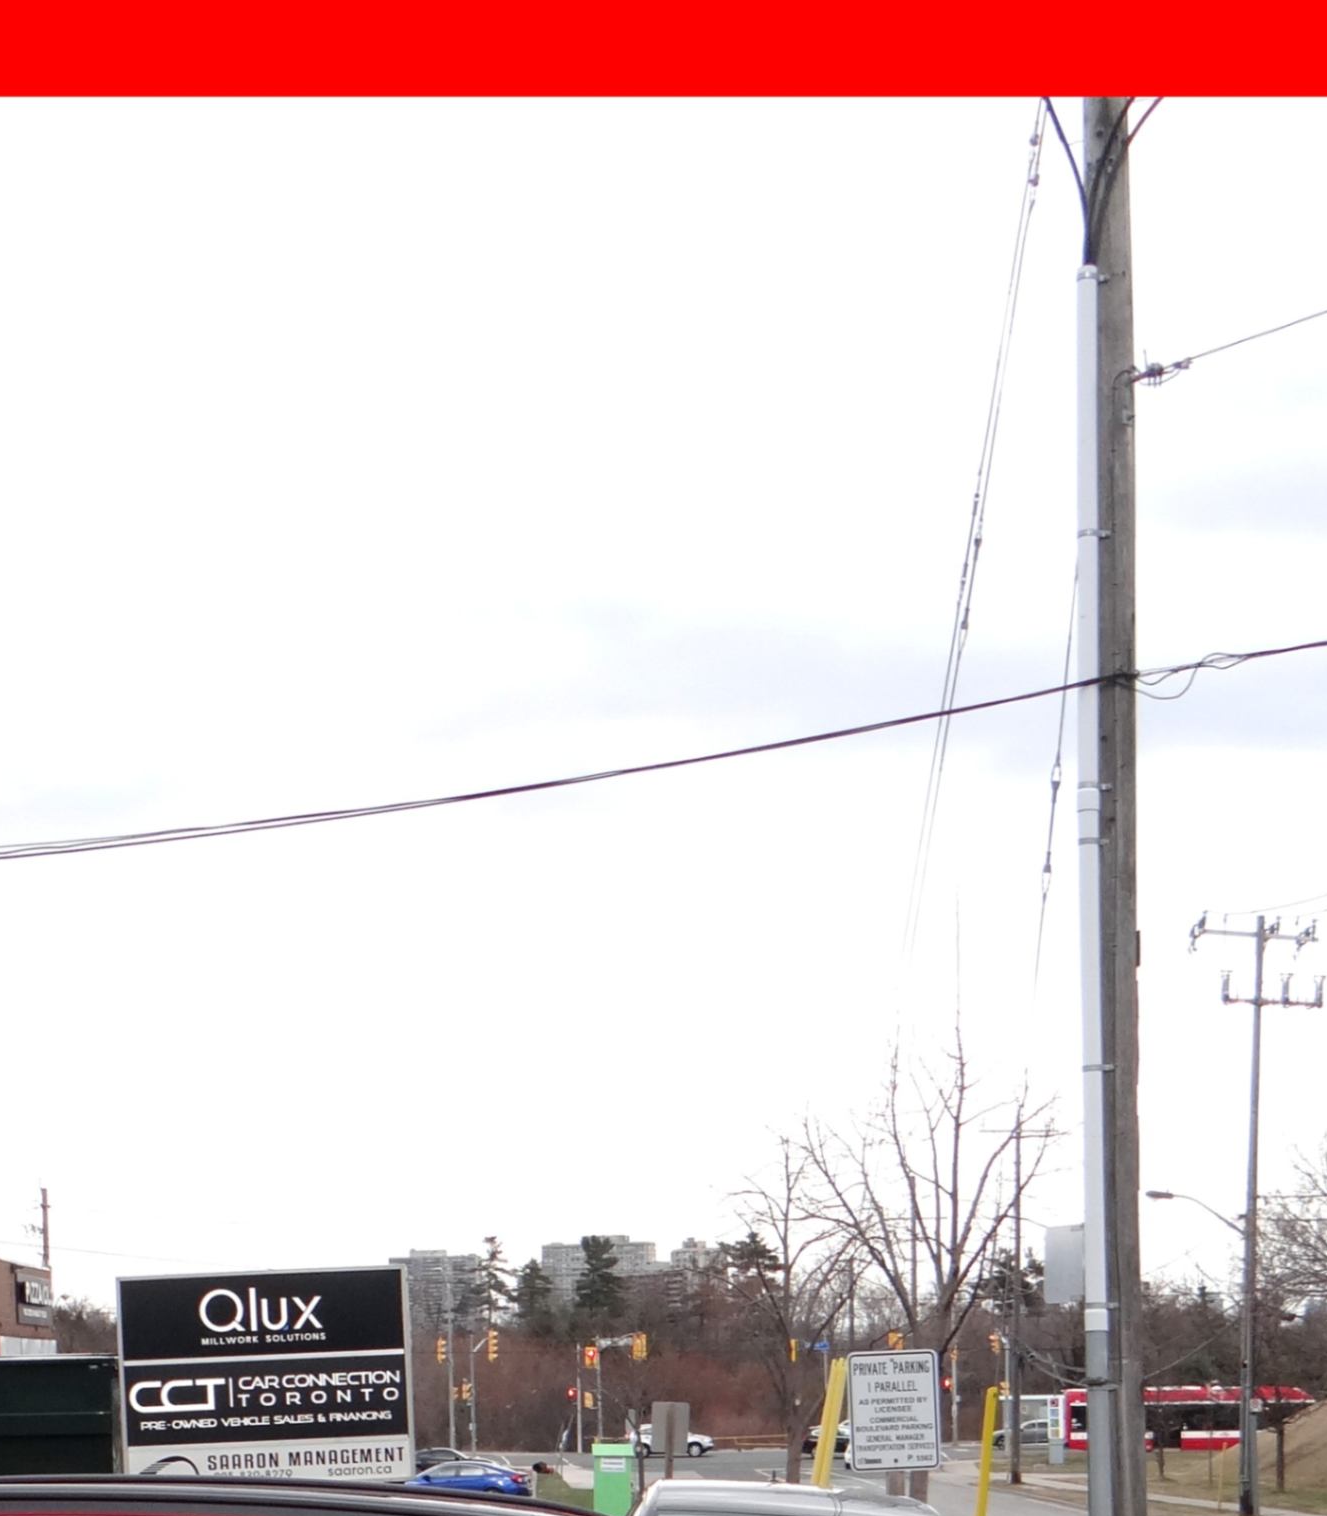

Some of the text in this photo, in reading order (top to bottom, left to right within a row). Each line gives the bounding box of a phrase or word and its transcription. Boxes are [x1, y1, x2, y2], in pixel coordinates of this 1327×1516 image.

[199, 1287, 323, 1332] Qlux
[201, 1332, 326, 1346] MILLWORK SOLUTIONS
[853, 1360, 930, 1376] PRIVATE PARKING
[237, 1370, 400, 1390] CAR CONNECTION
[874, 1380, 918, 1393] PARALLEL
[129, 1377, 225, 1414] CCT
[237, 1387, 400, 1408] TORONTO
[221, 1415, 270, 1427] VEHICLE
[274, 1413, 314, 1425] SALES
[317, 1413, 326, 1423] &
[329, 1410, 392, 1423] FINANCING
[207, 1446, 406, 1471] SAARON MANAGEMENT
[328, 1463, 392, 1478] saaron.ca
